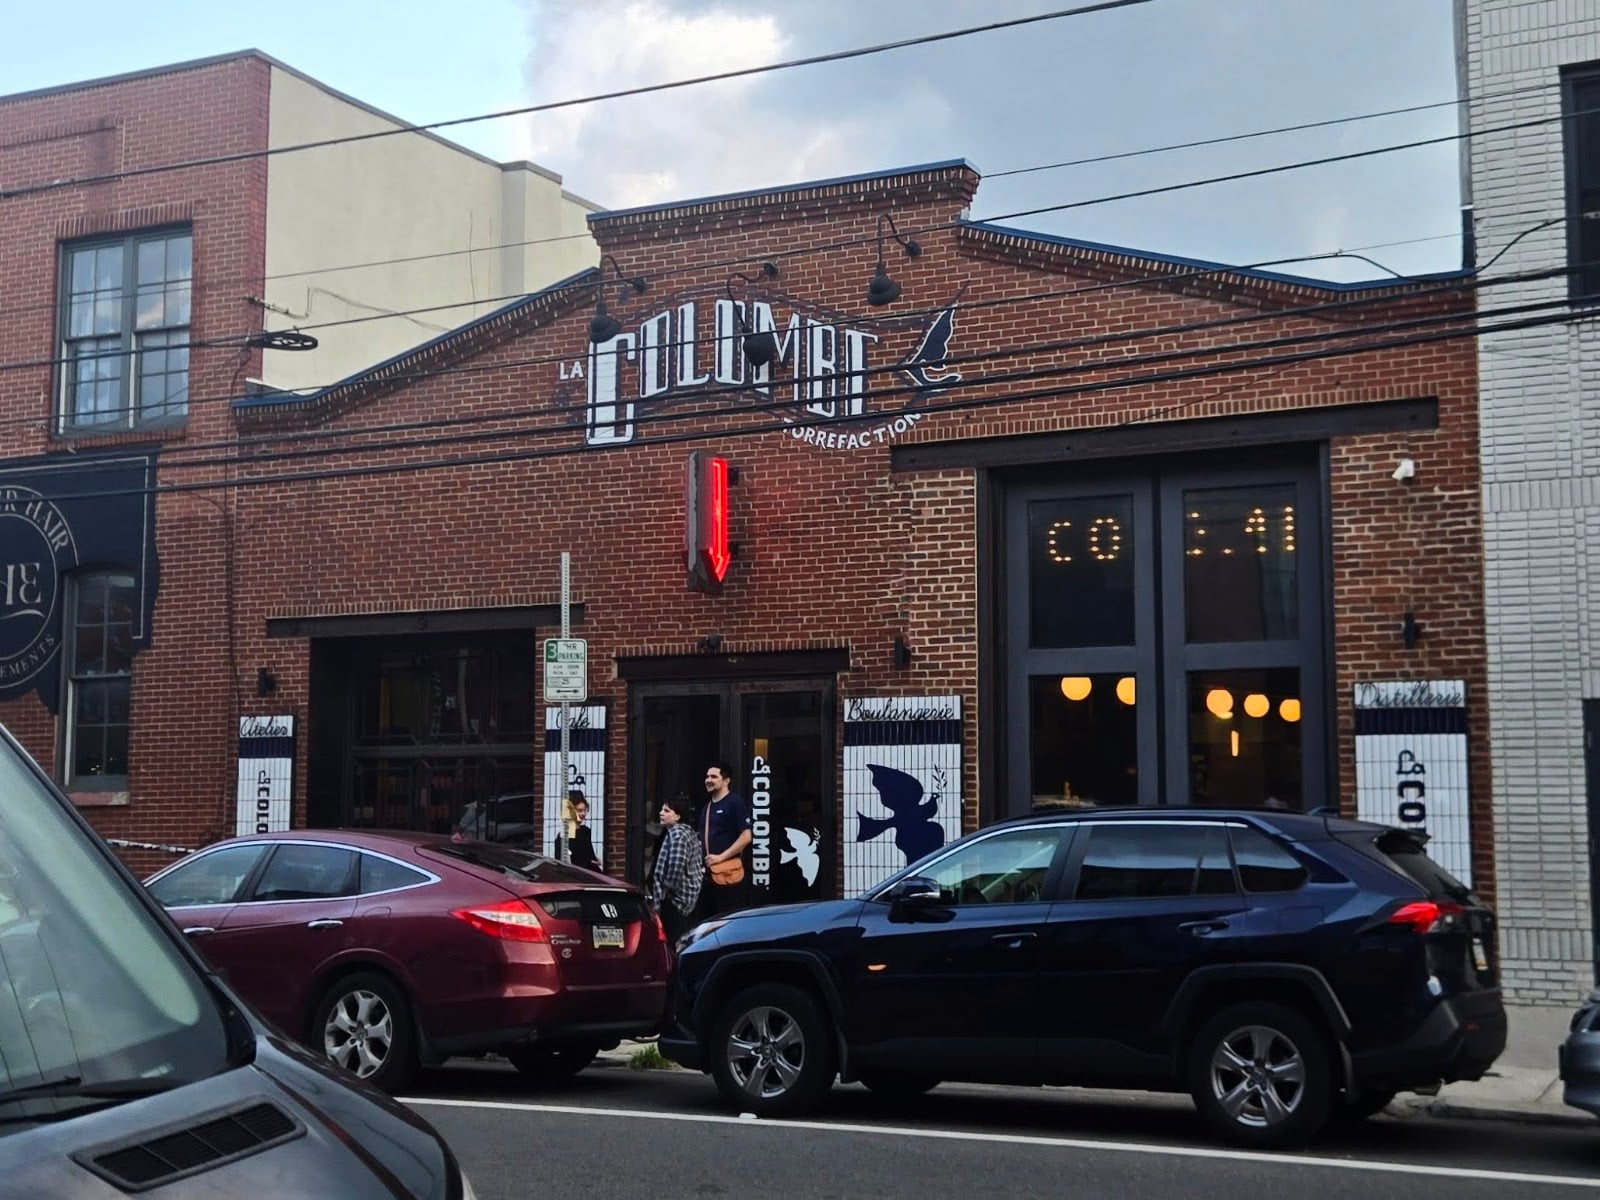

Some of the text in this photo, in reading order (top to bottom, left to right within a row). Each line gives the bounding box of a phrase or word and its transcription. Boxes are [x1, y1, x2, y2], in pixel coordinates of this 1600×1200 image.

[560, 361, 584, 379] LA
[548, 643, 557, 659] 3
[559, 652, 584, 660] PARKING
[847, 696, 955, 721] Boulangerie
[1396, 750, 1427, 834] La CO
[752, 756, 771, 886] La COLOMBE
